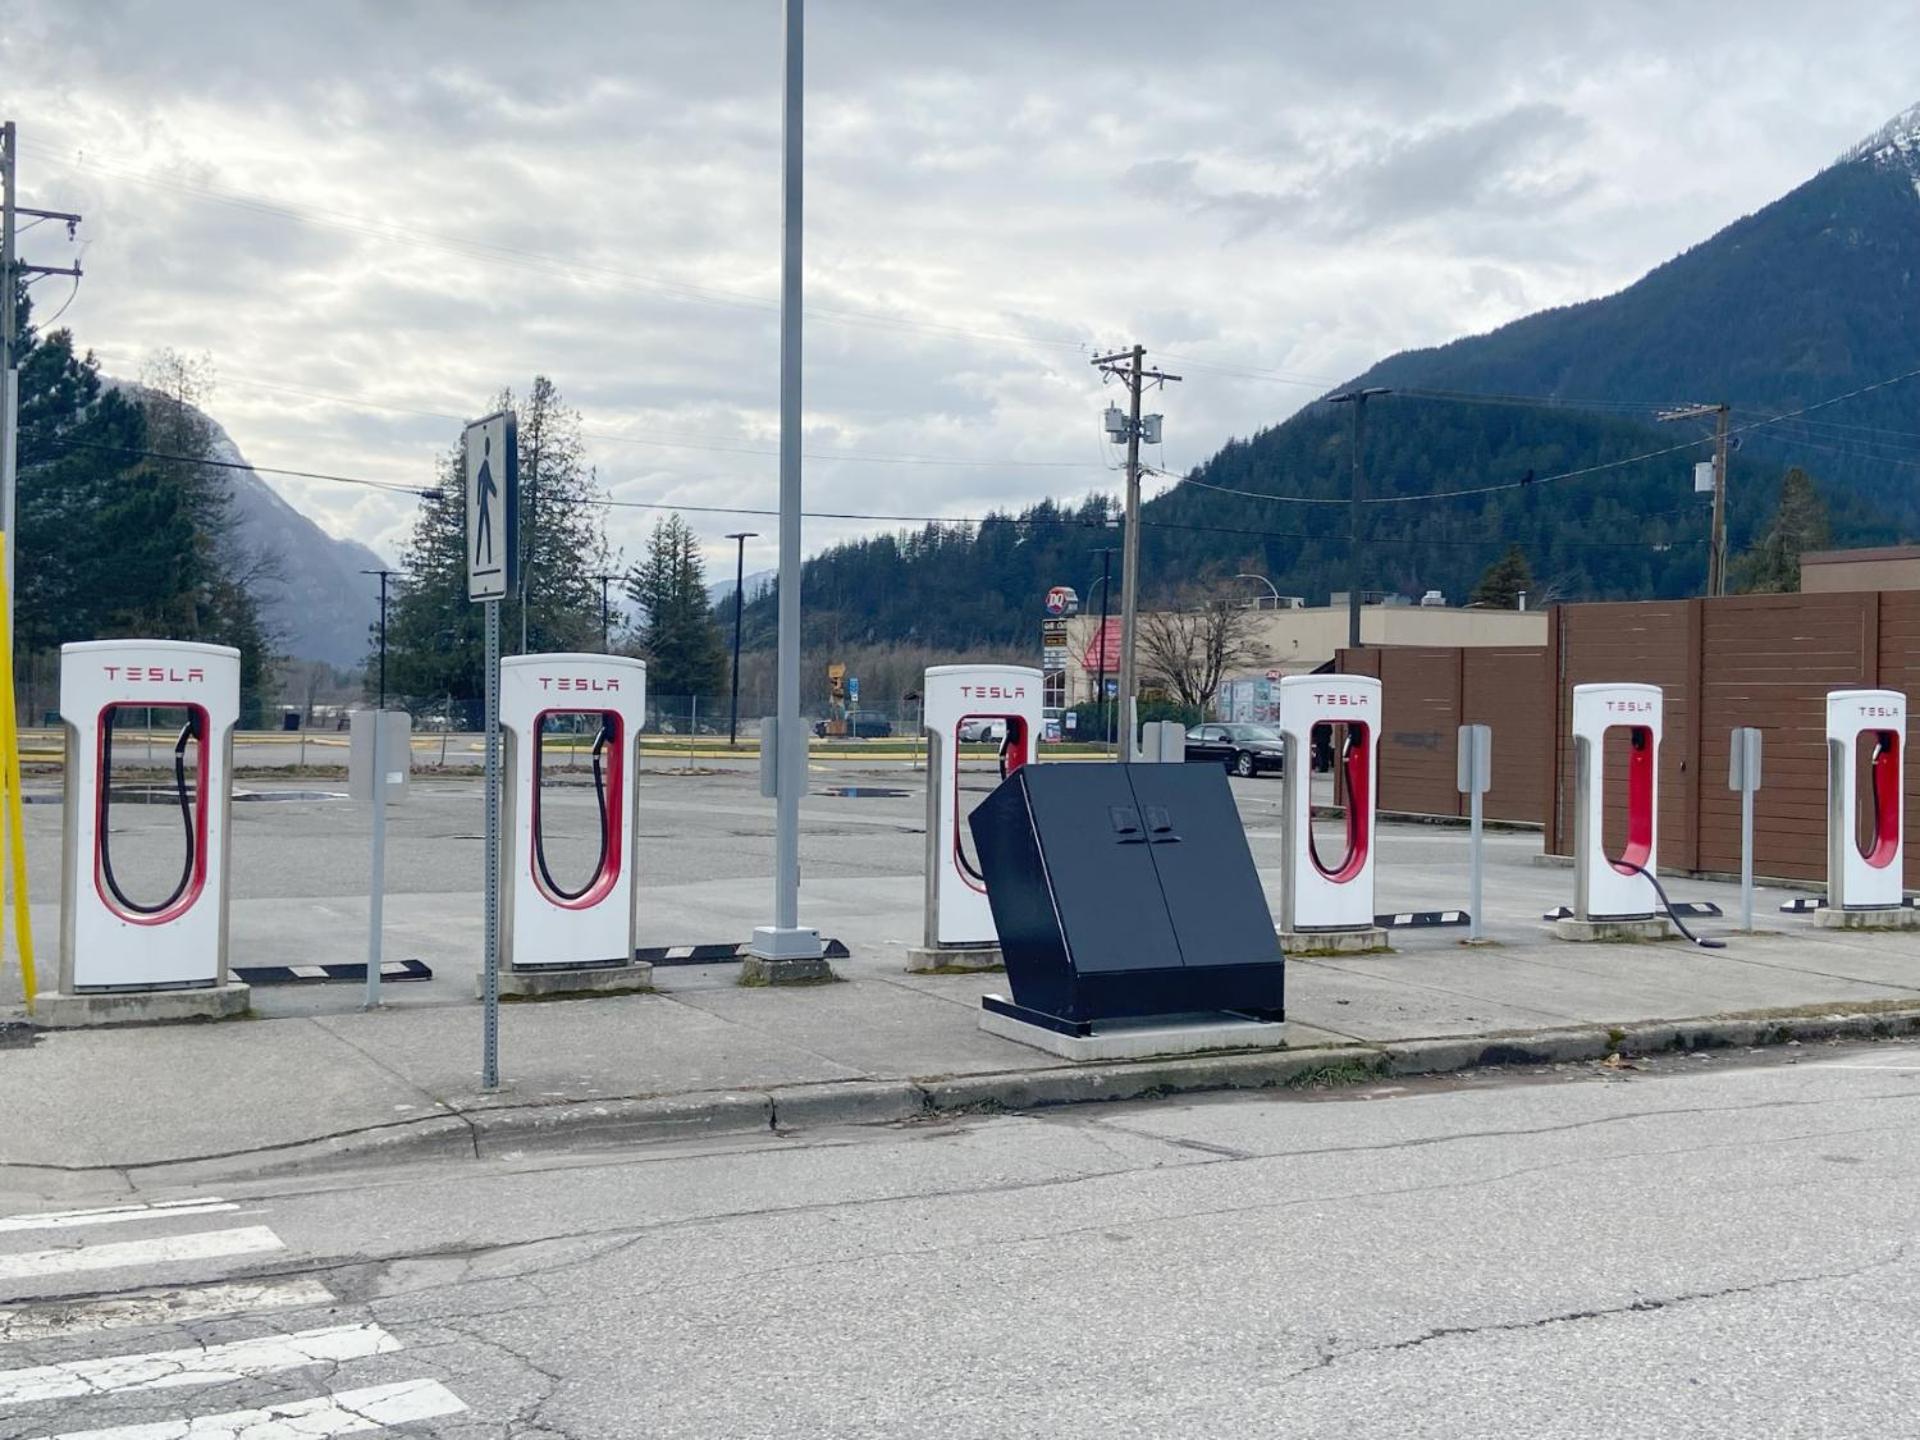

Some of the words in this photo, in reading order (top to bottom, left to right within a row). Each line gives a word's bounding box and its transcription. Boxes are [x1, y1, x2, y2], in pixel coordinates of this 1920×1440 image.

[1050, 593, 1064, 607] DQ
[104, 667, 204, 682] TESLA
[539, 678, 620, 691] TESLA
[960, 687, 1025, 699] TESLA
[1313, 695, 1368, 706] TESLA
[1607, 702, 1652, 712] TESLA
[1859, 707, 1899, 717] TESLA
